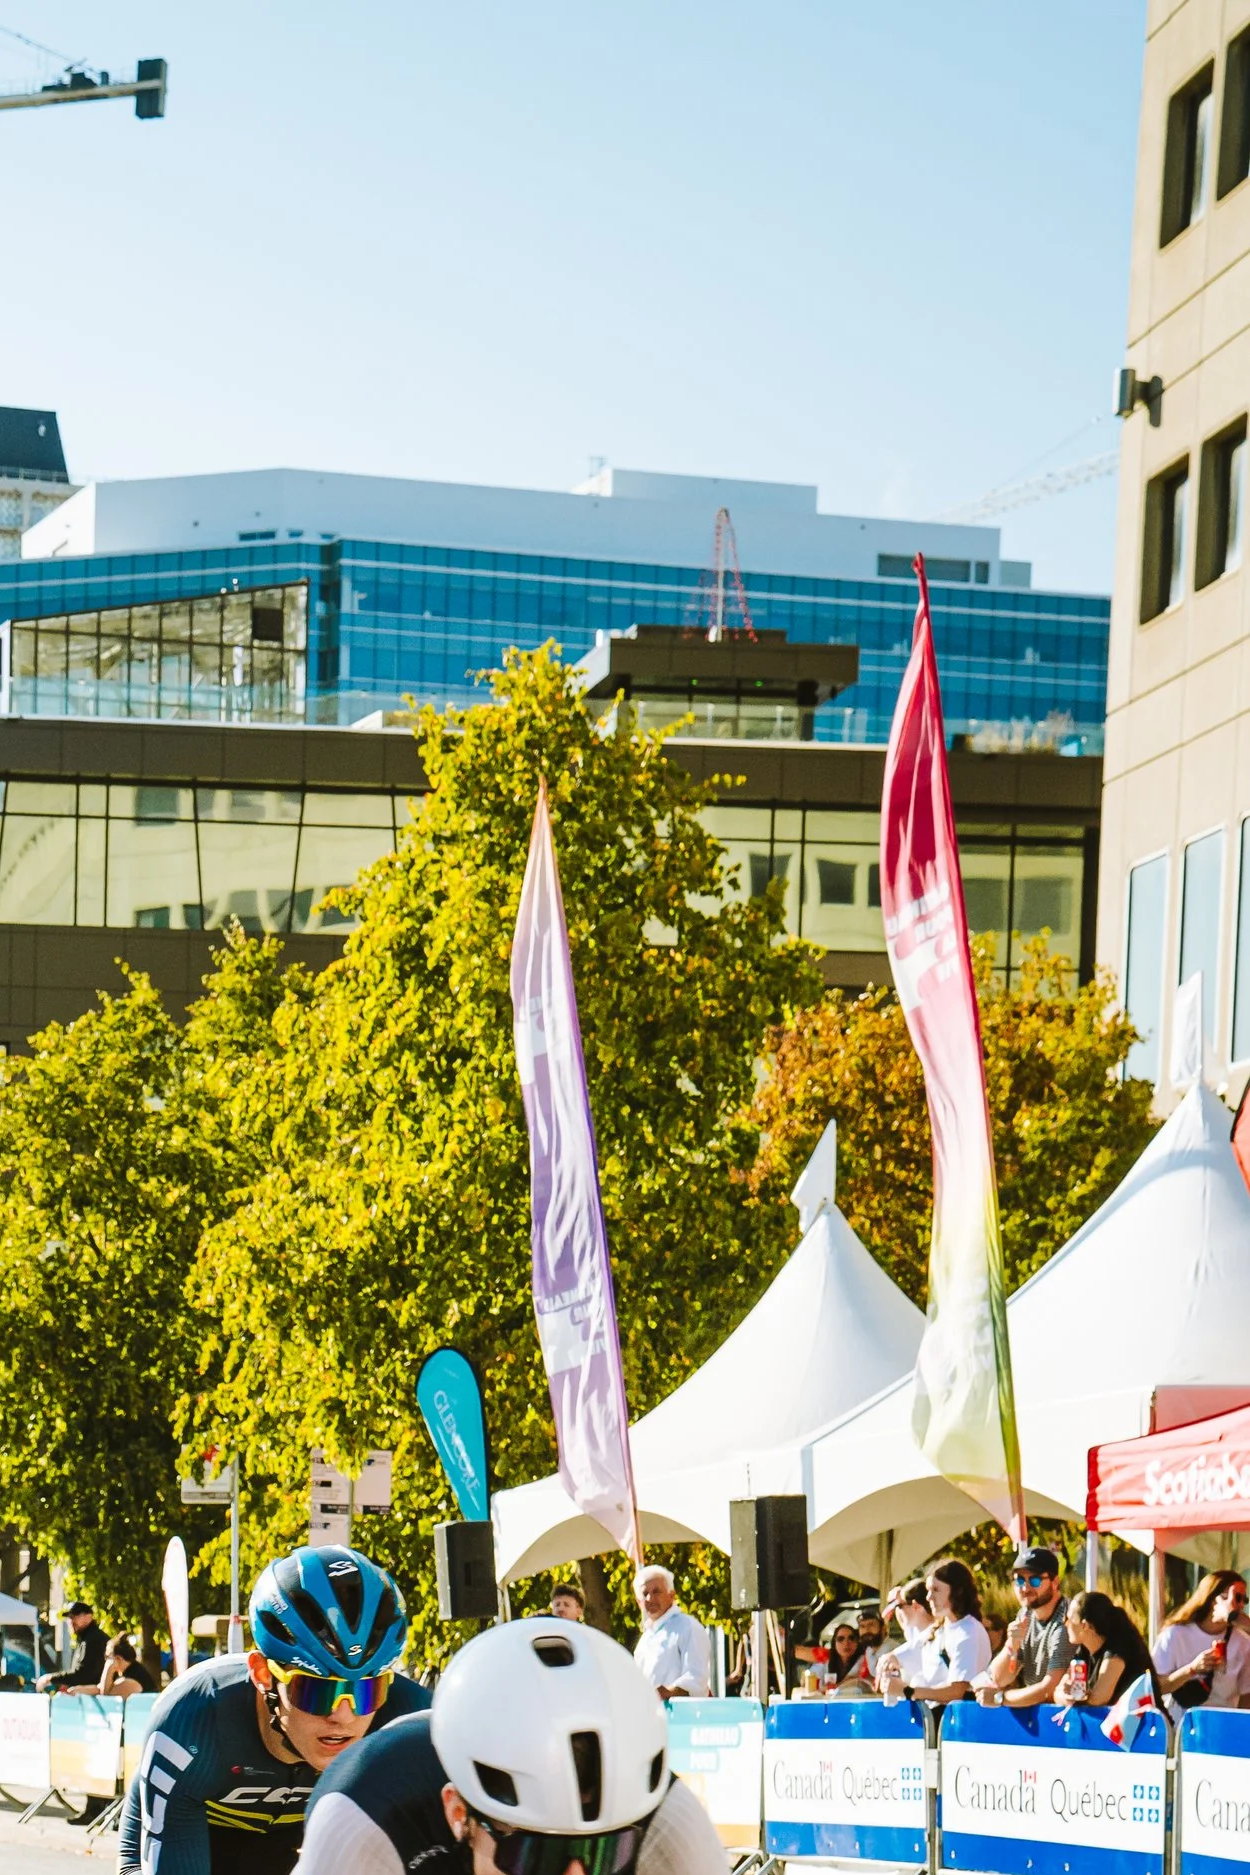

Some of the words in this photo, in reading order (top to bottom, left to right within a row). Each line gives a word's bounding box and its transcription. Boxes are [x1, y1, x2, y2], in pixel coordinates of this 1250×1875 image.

[773, 1760, 833, 1800] Canada
[842, 1766, 899, 1805] Québec
[954, 1765, 1036, 1815] Canada
[1050, 1778, 1127, 1823] Québec
